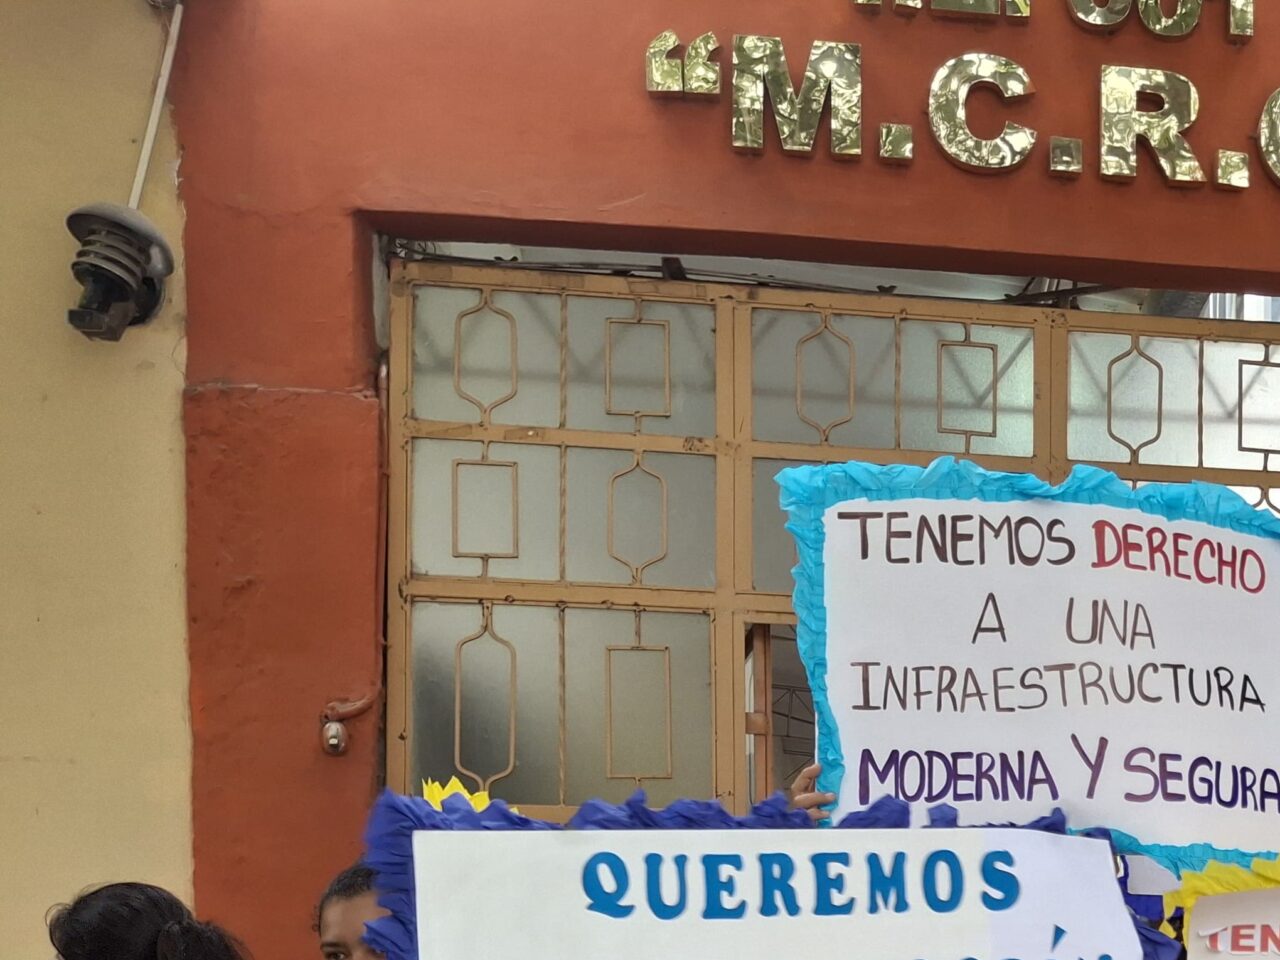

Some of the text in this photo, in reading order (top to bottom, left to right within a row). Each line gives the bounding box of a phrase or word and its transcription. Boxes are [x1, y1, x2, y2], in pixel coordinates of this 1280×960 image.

[838, 512, 1267, 593] TENEMOS DERECHO
[972, 592, 1155, 649] A UNA
[851, 662, 1266, 713] INFRAESTRUCTURA
[859, 749, 1058, 804] MODERNA
[1071, 734, 1108, 799] Y
[582, 849, 1021, 921] QUEREMOS
